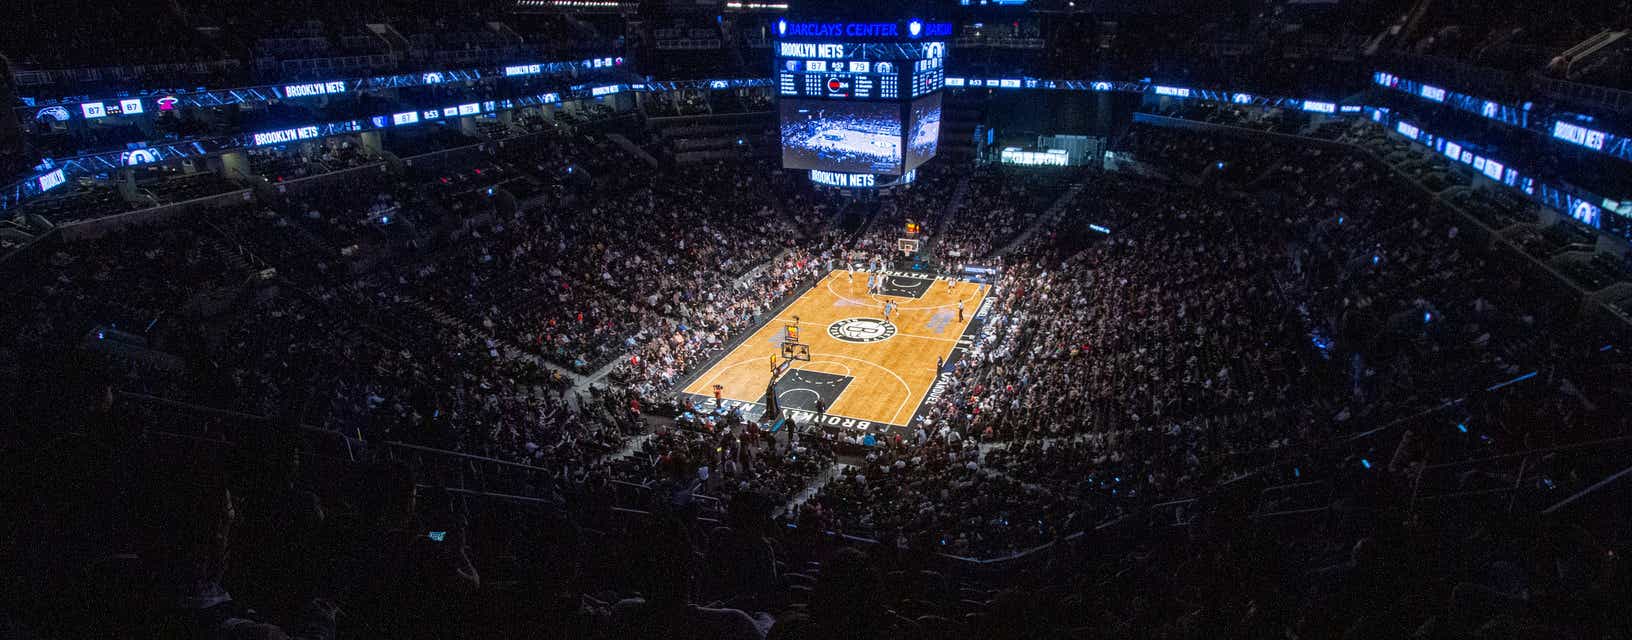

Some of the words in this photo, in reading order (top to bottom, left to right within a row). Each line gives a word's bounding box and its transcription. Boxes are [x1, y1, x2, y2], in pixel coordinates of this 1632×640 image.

[789, 24, 842, 36] BARCLAYS
[845, 24, 898, 36] CENTER
[781, 43, 816, 58] BROOKLYN
[818, 44, 844, 59] NETS
[286, 83, 325, 97] BROOKLYN
[326, 81, 345, 94] NETS
[88, 107, 99, 115] 87
[127, 103, 137, 111] 87
[424, 110, 439, 119] 8:53
[255, 129, 297, 145] BROOKLYN
[297, 126, 318, 139] NETS
[812, 170, 847, 186] BROOKLYN
[850, 174, 874, 186] NETS
